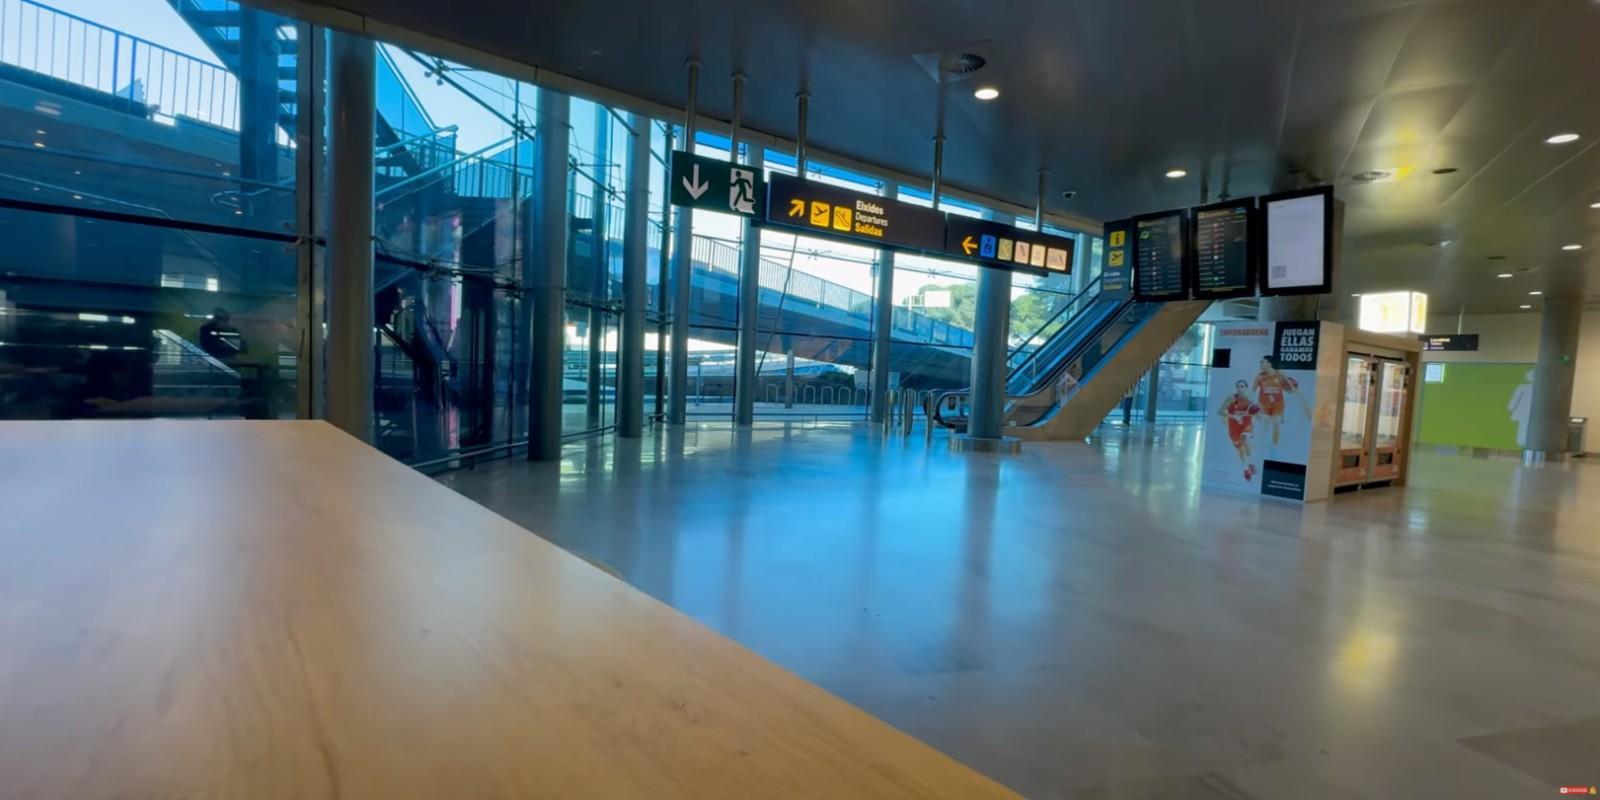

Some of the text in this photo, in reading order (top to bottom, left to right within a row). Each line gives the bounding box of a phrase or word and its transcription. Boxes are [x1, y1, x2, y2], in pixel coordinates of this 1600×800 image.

[856, 200, 884, 215] Eixides
[855, 212, 888, 226] Departures
[855, 223, 883, 237] Salidas
[1282, 328, 1315, 336] JUEGAN
[1280, 336, 1314, 346] ELLAS
[1280, 353, 1313, 362] TODOS
